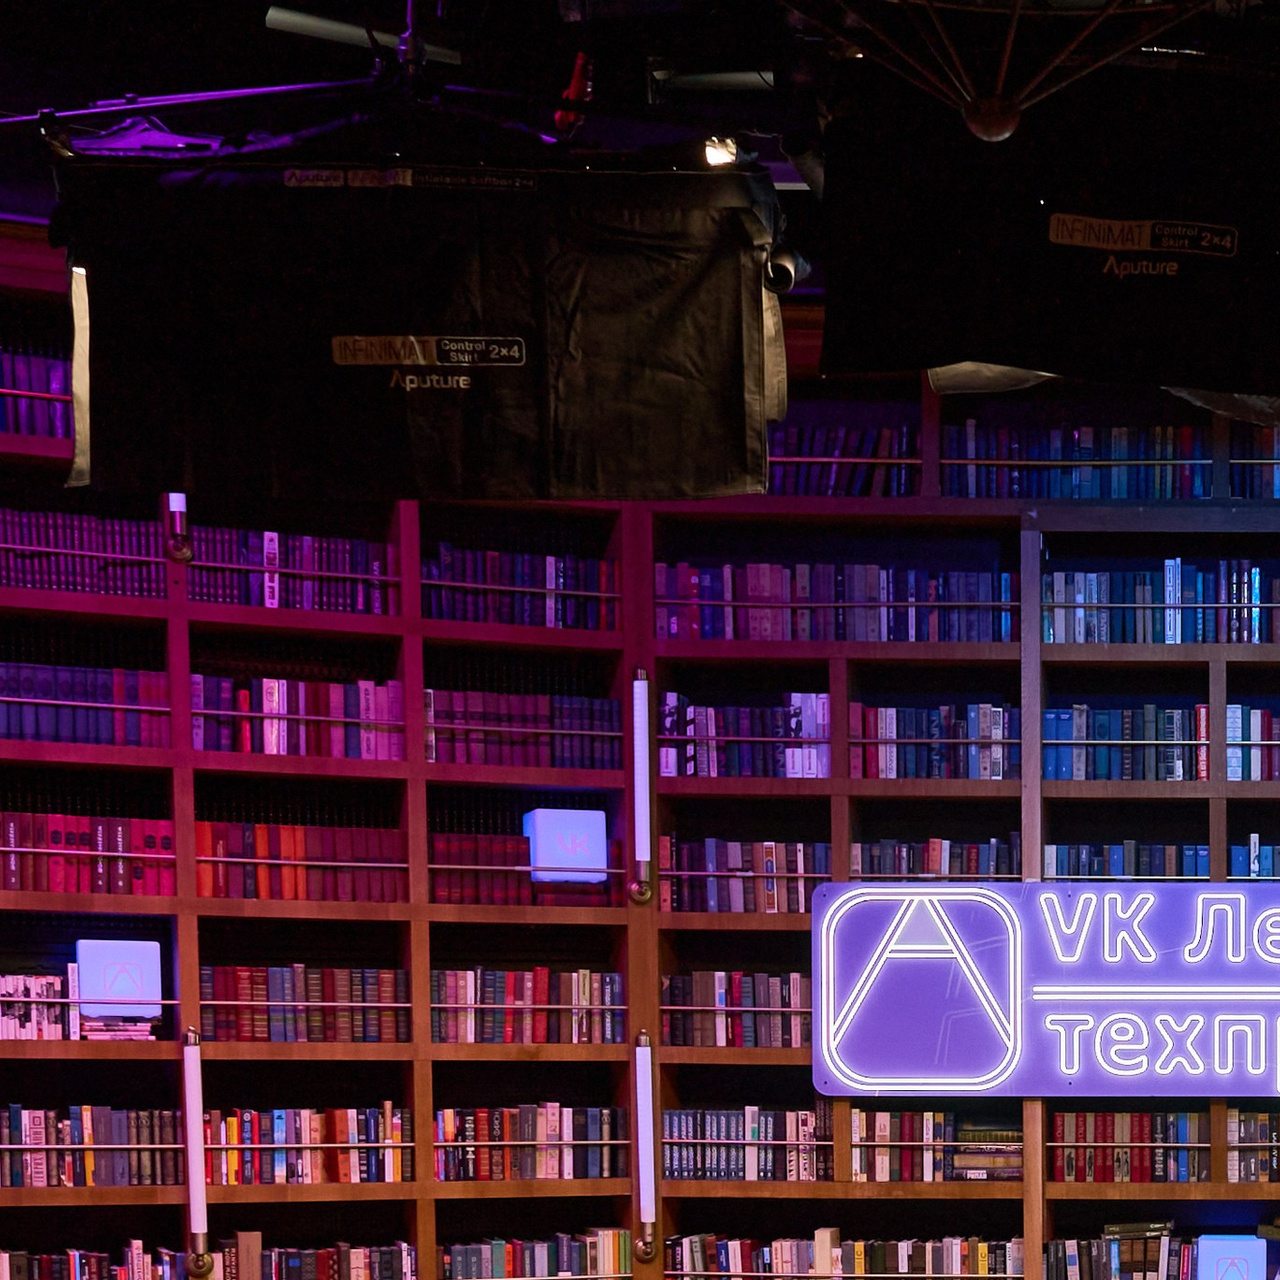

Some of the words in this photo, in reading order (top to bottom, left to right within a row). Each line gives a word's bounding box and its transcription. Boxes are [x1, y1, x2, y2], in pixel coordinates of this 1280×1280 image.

[1155, 223, 1198, 237] Control
[441, 340, 486, 352] Control
[1040, 892, 1158, 964] VK
